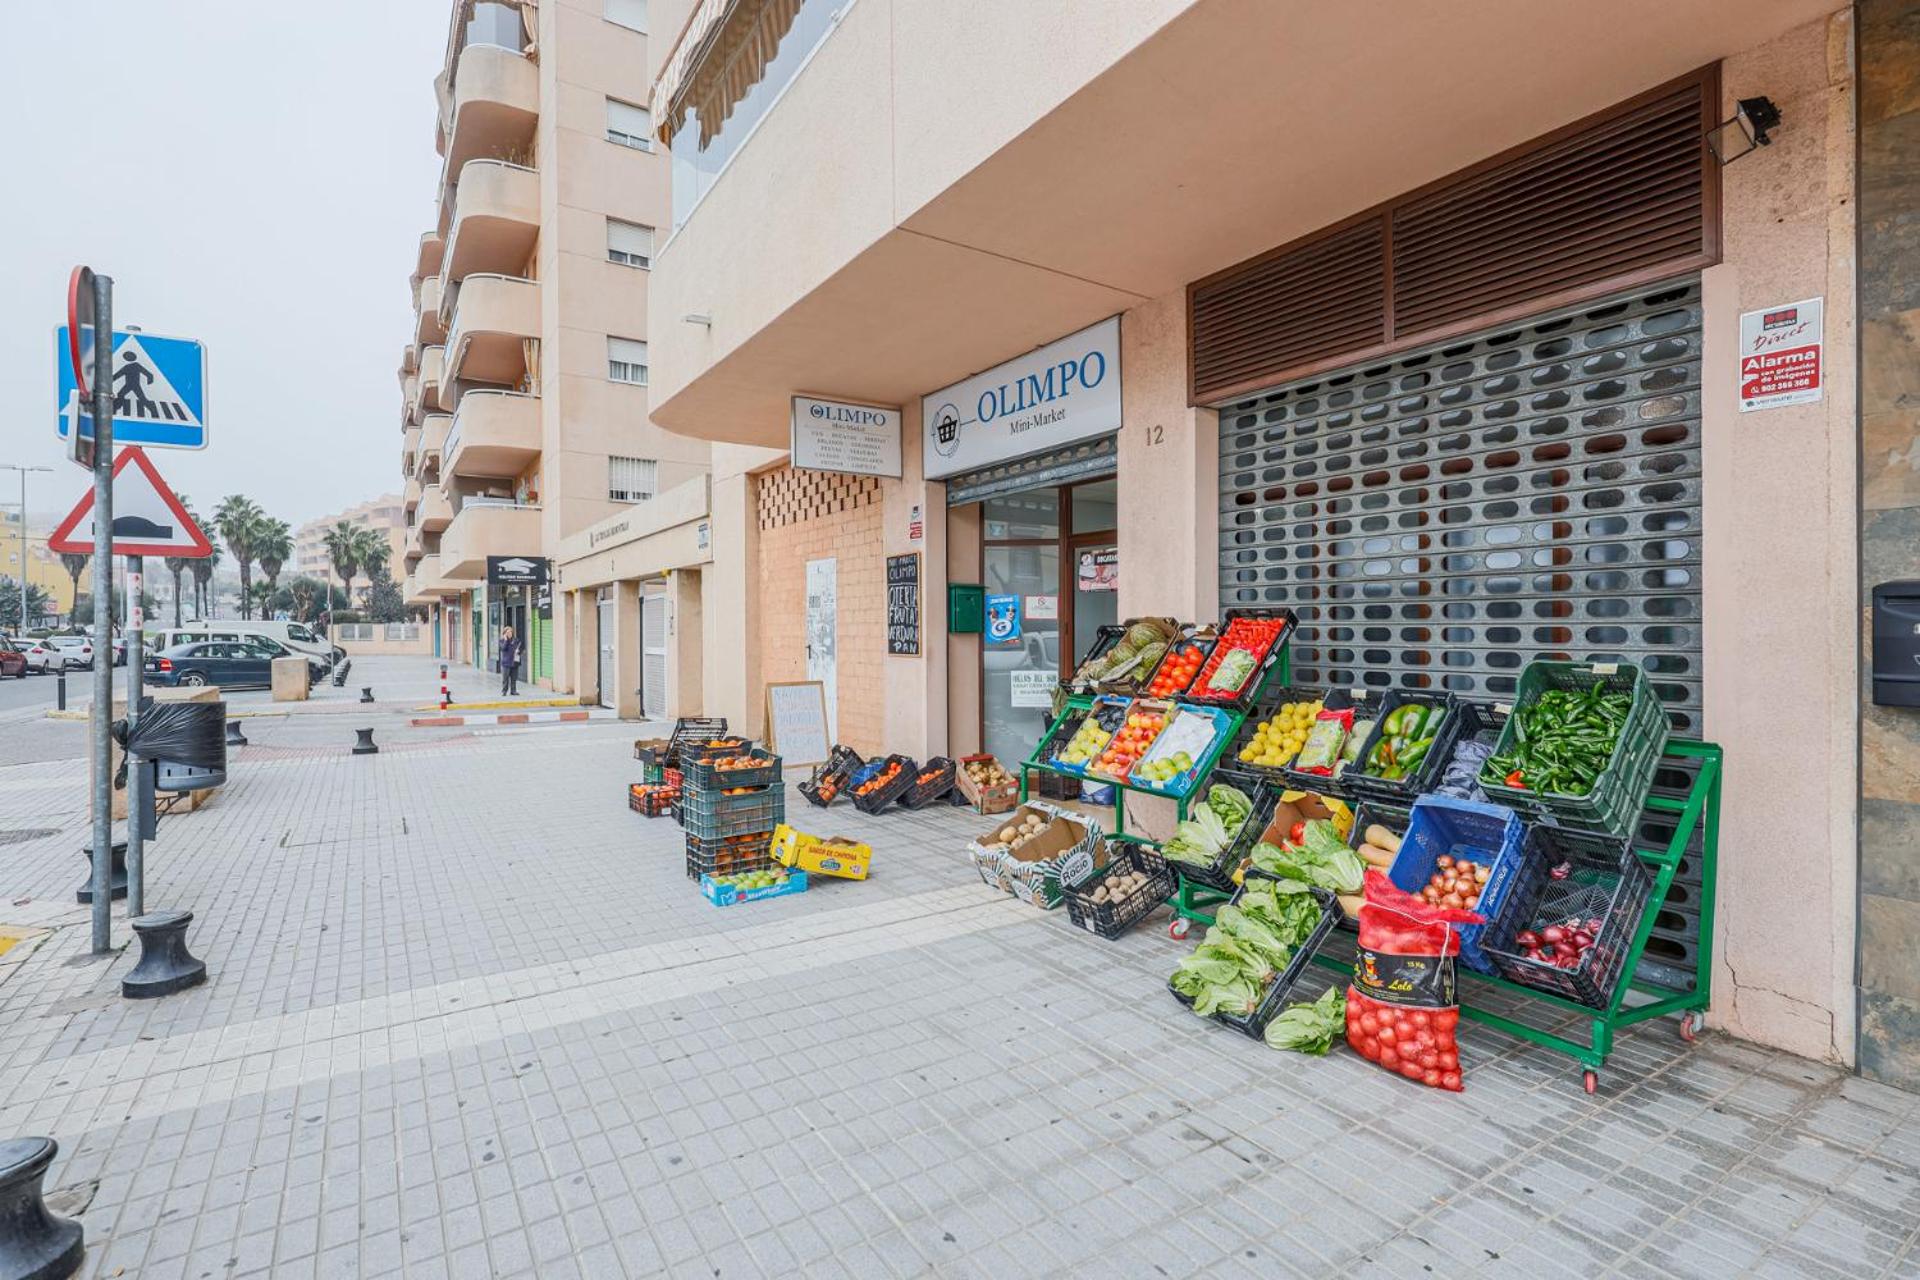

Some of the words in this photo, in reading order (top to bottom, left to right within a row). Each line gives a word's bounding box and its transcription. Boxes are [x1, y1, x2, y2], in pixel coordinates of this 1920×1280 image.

[1744, 350, 1816, 372] Alarma
[977, 351, 1106, 423] OLIMPO
[809, 404, 886, 427] OLIMPO
[1010, 407, 1066, 435] Mini-Market
[1146, 424, 1164, 446] 12
